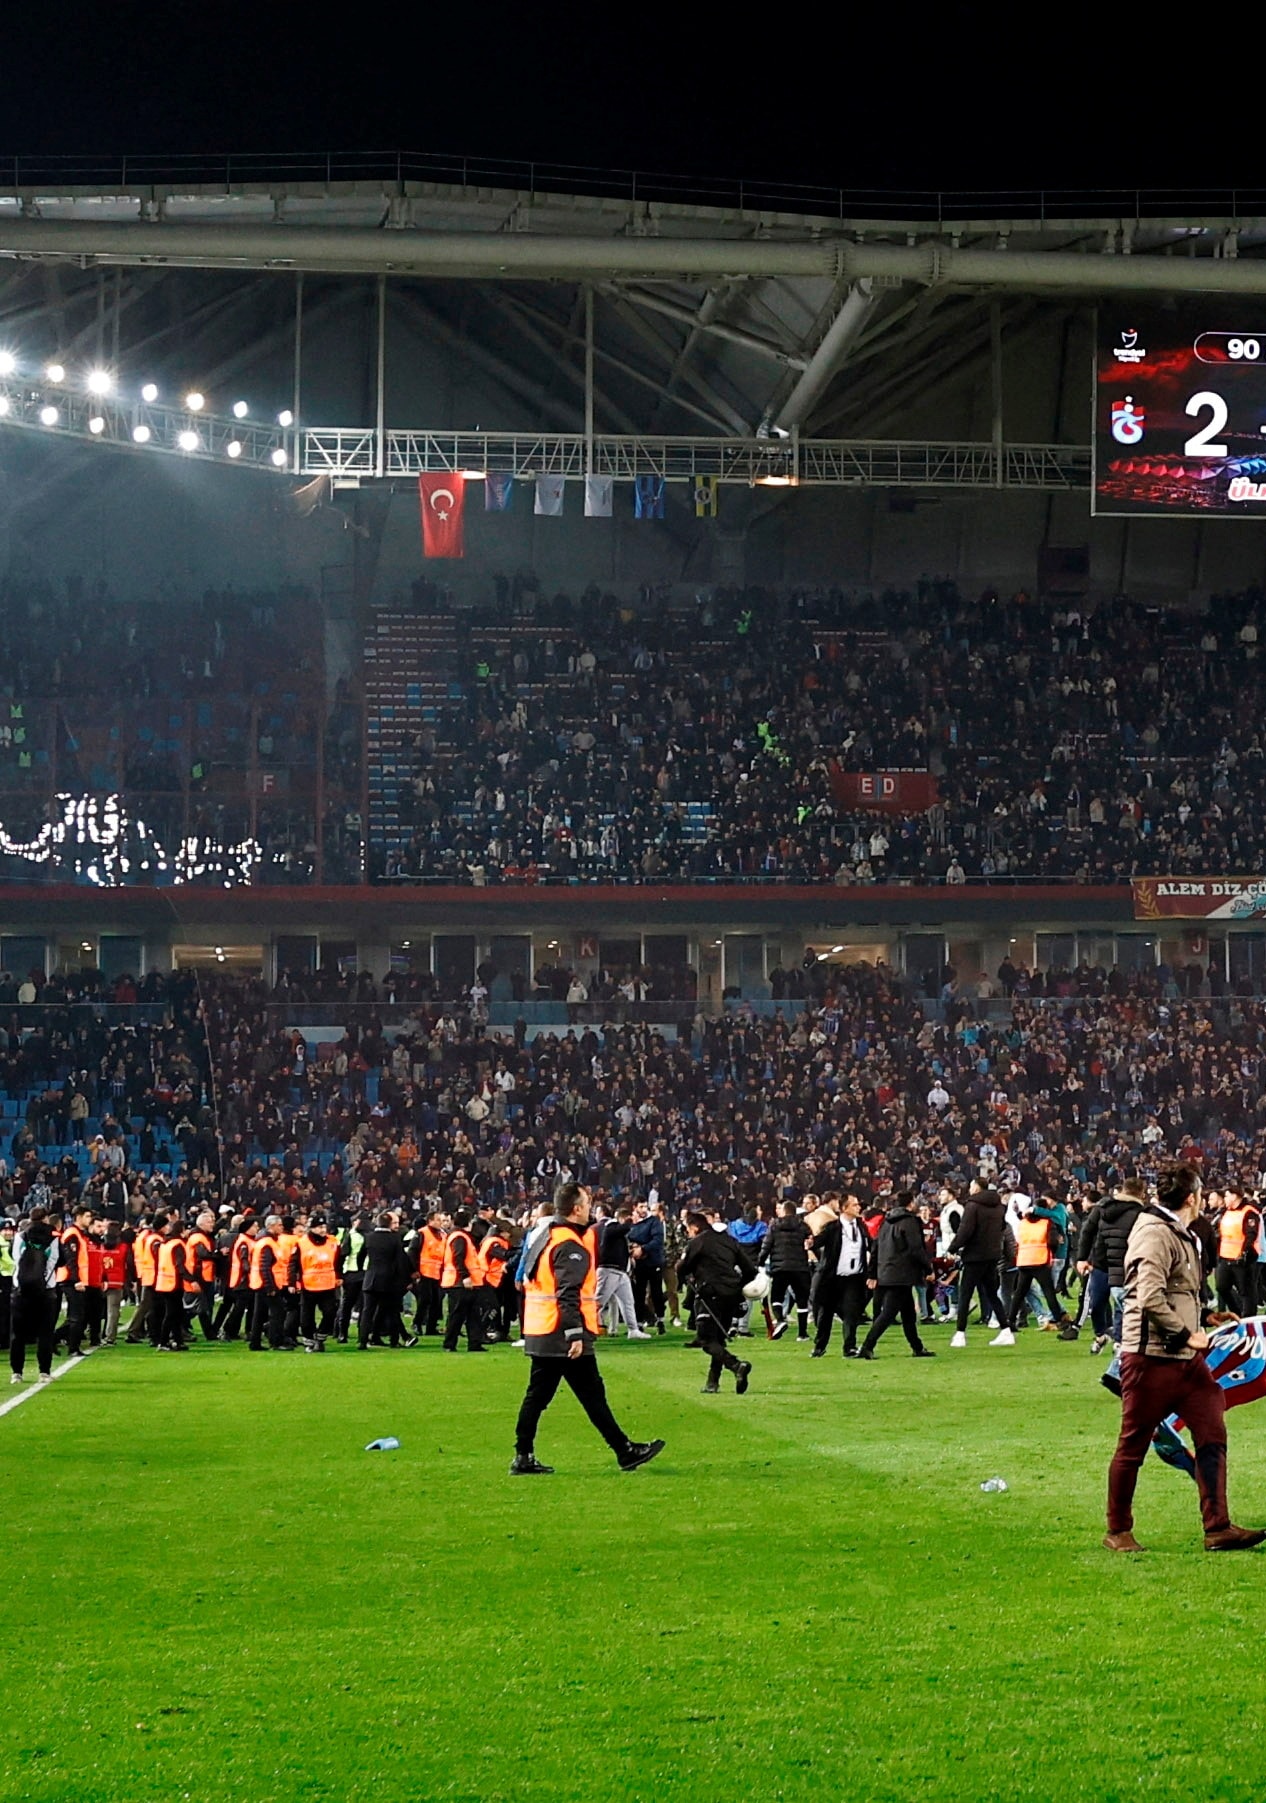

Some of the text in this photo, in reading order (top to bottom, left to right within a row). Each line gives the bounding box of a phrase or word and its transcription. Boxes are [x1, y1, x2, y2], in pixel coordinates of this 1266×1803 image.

[1185, 391, 1228, 457] 2
[263, 775, 274, 792] F
[861, 778, 895, 793] E D
[1157, 883, 1206, 896] ALEM
[1211, 881, 1242, 896] DİZ
[581, 938, 594, 955] K
